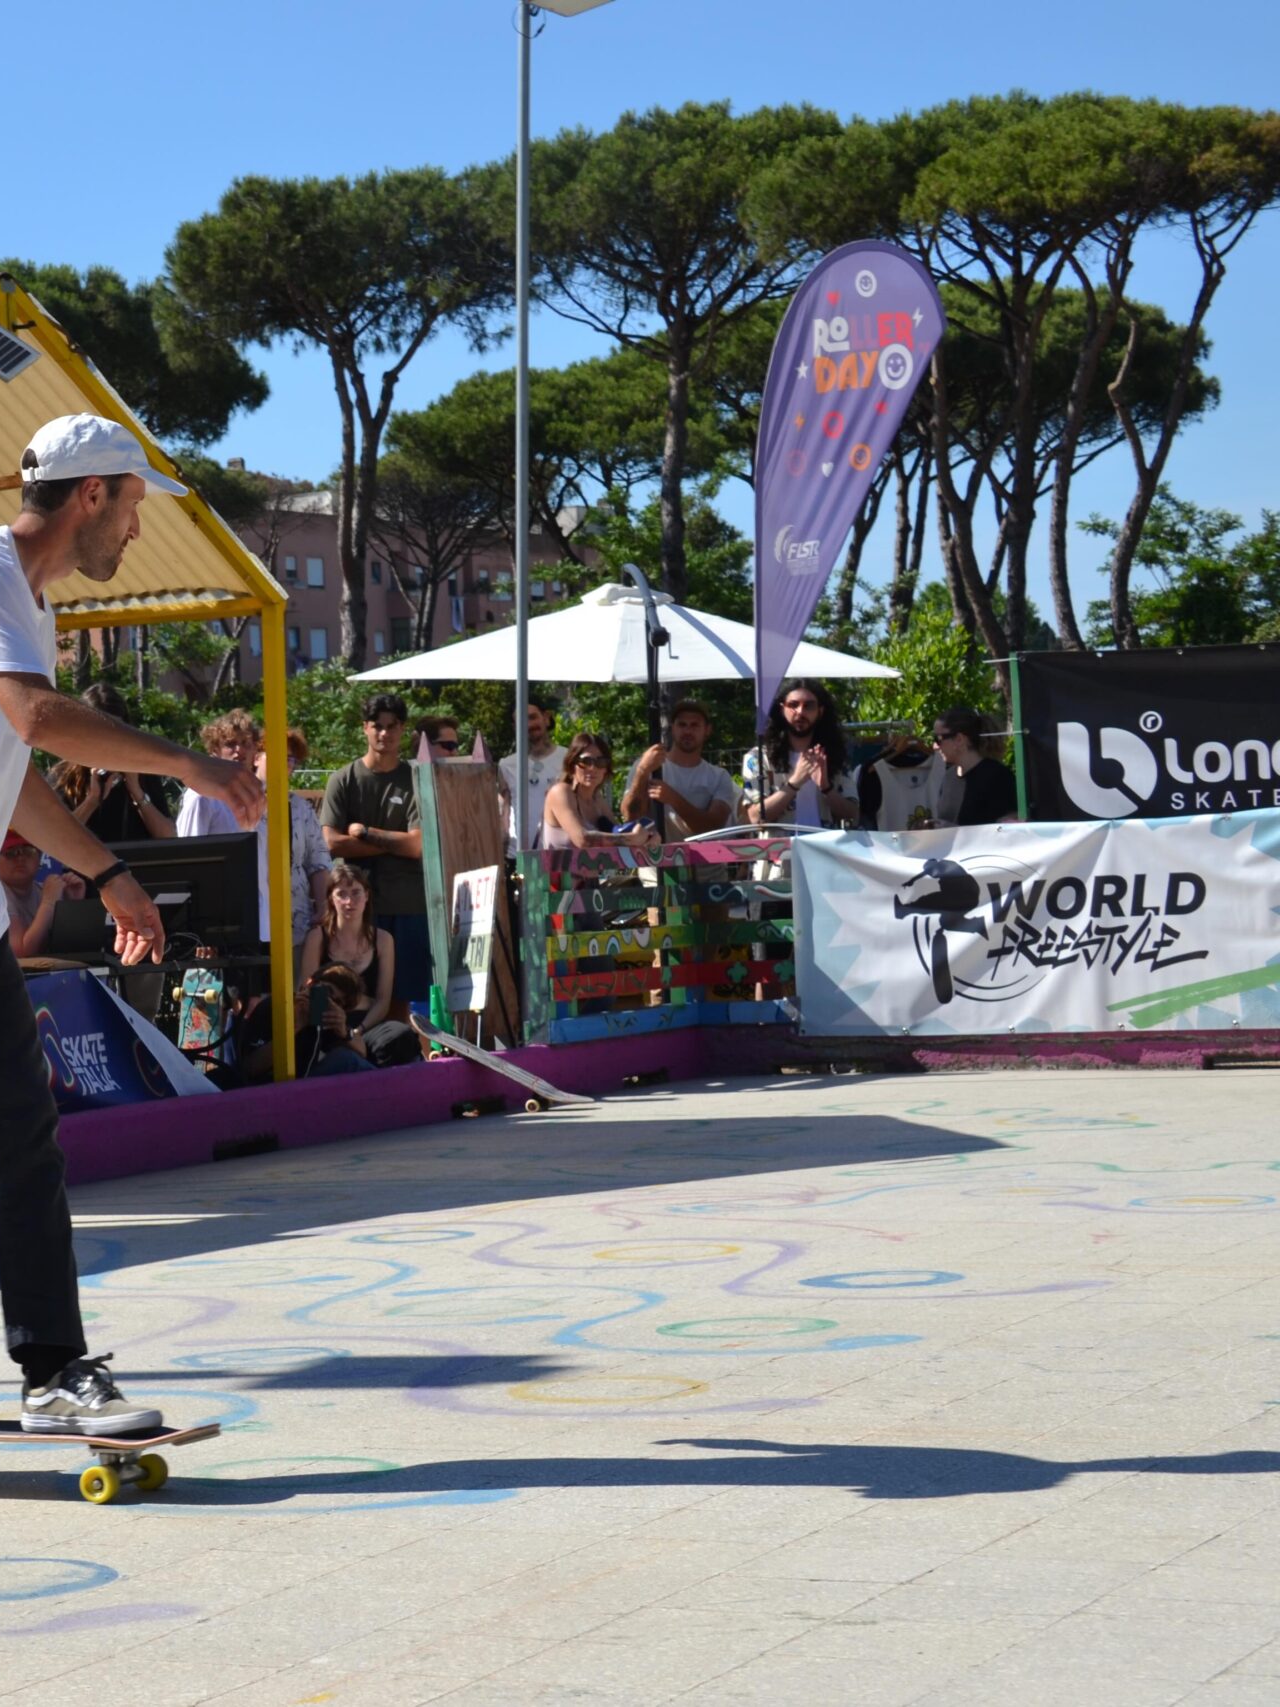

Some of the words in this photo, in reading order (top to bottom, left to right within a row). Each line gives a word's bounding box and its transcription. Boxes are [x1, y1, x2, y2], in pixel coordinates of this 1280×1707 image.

[813, 311, 915, 357] ROLLER
[814, 351, 879, 394] DAY
[987, 871, 1207, 923] WORLD
[987, 911, 1209, 982] FREESTYLE
[61, 1032, 108, 1067] SKATE
